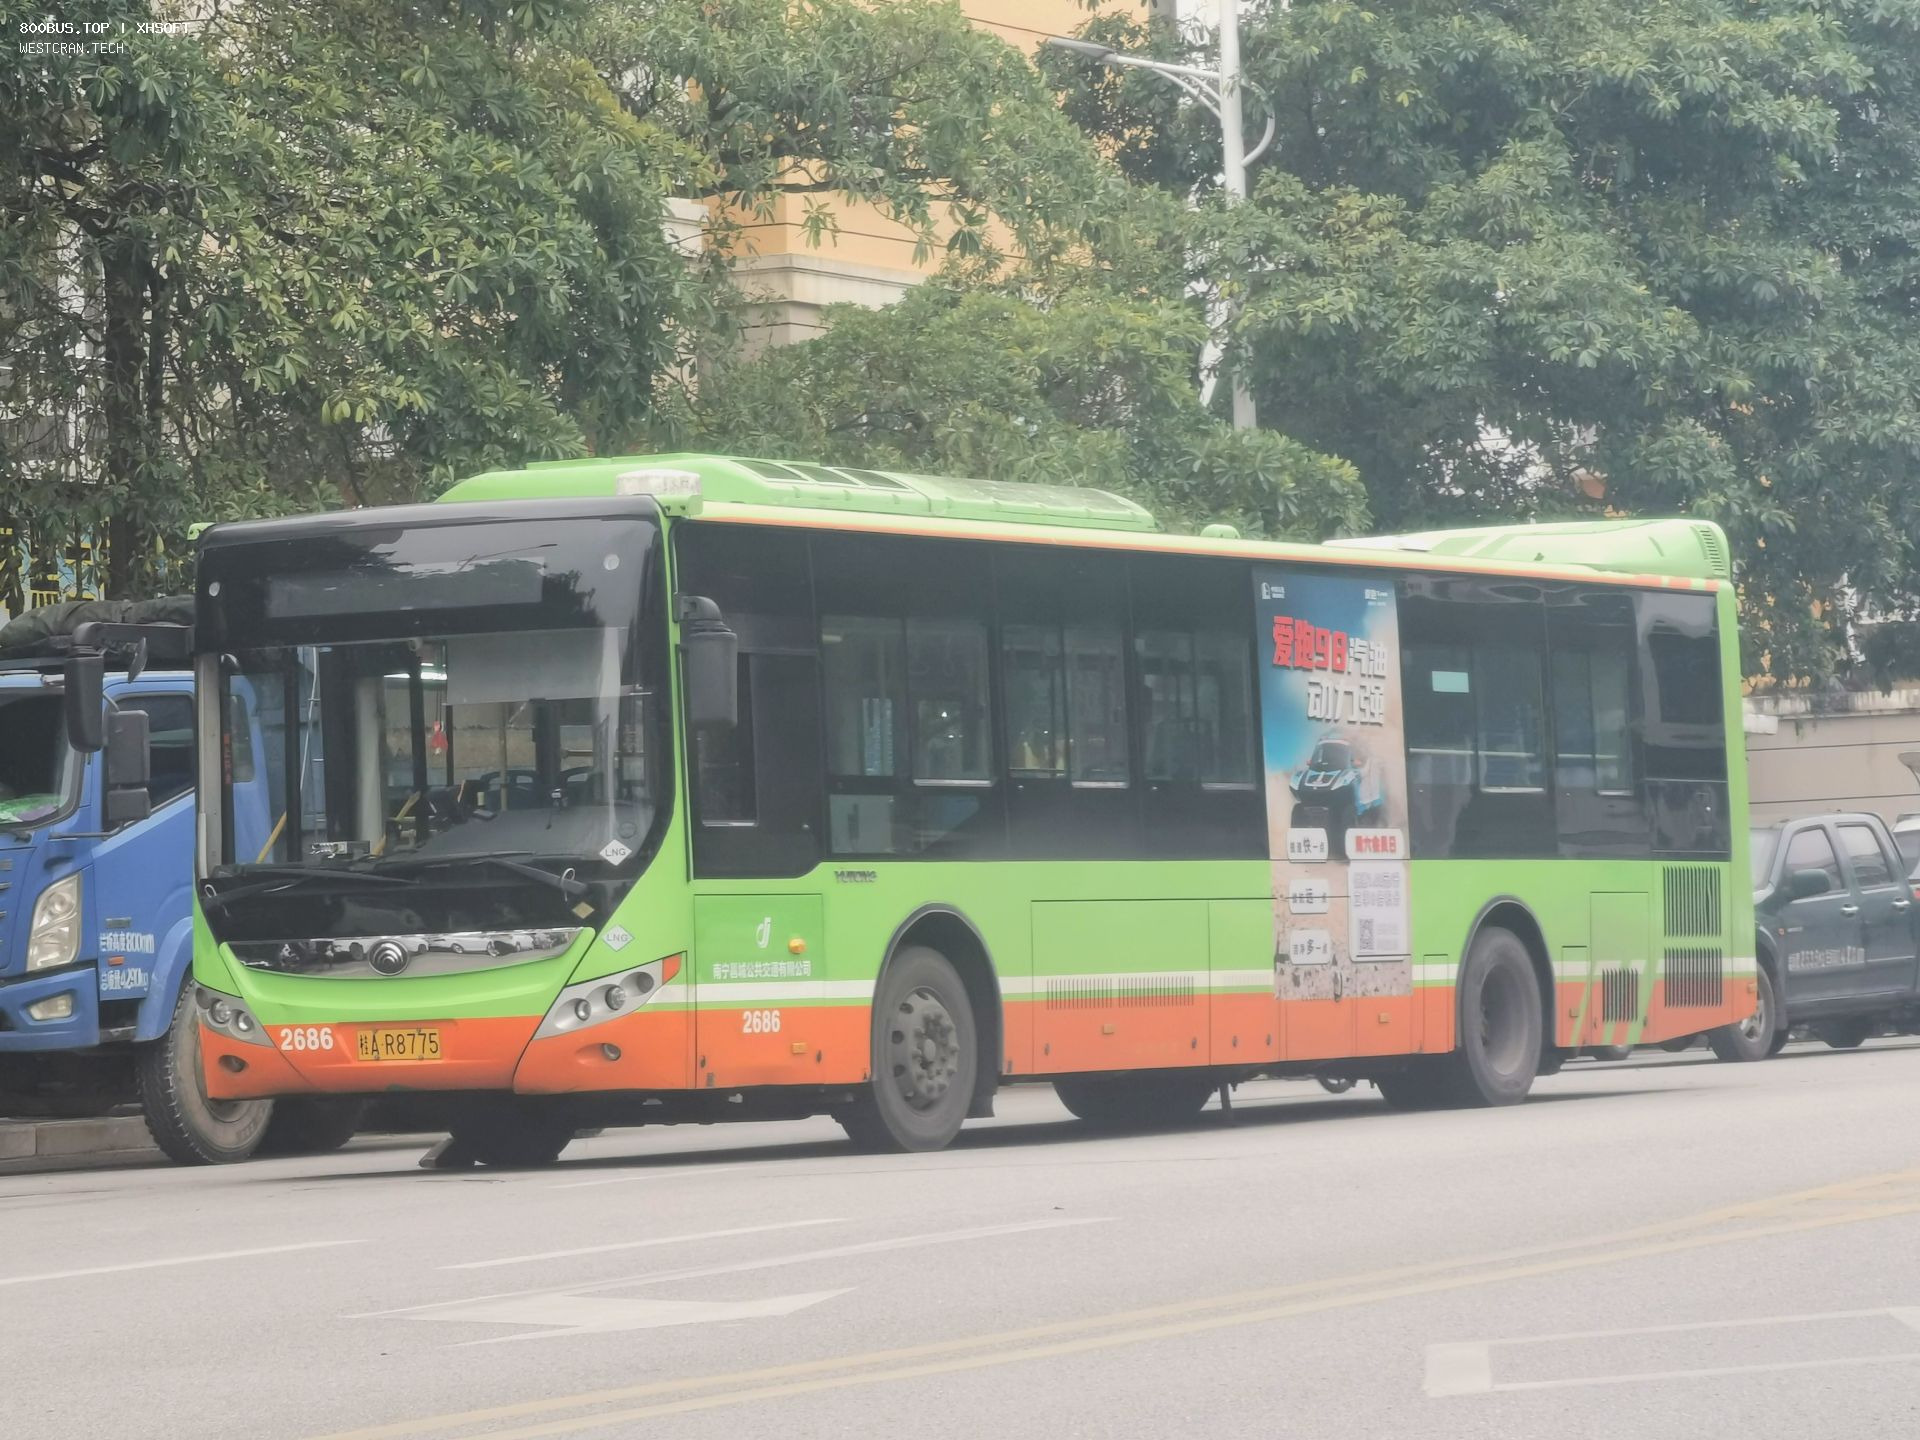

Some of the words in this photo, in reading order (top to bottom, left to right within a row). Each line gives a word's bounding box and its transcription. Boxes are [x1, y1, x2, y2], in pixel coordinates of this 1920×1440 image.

[1273, 616, 1388, 679] 爱跑98汽油
[605, 847, 627, 858] LNG
[606, 933, 629, 943] LNG
[743, 1010, 781, 1034] 2686
[279, 1026, 334, 1051] 2686
